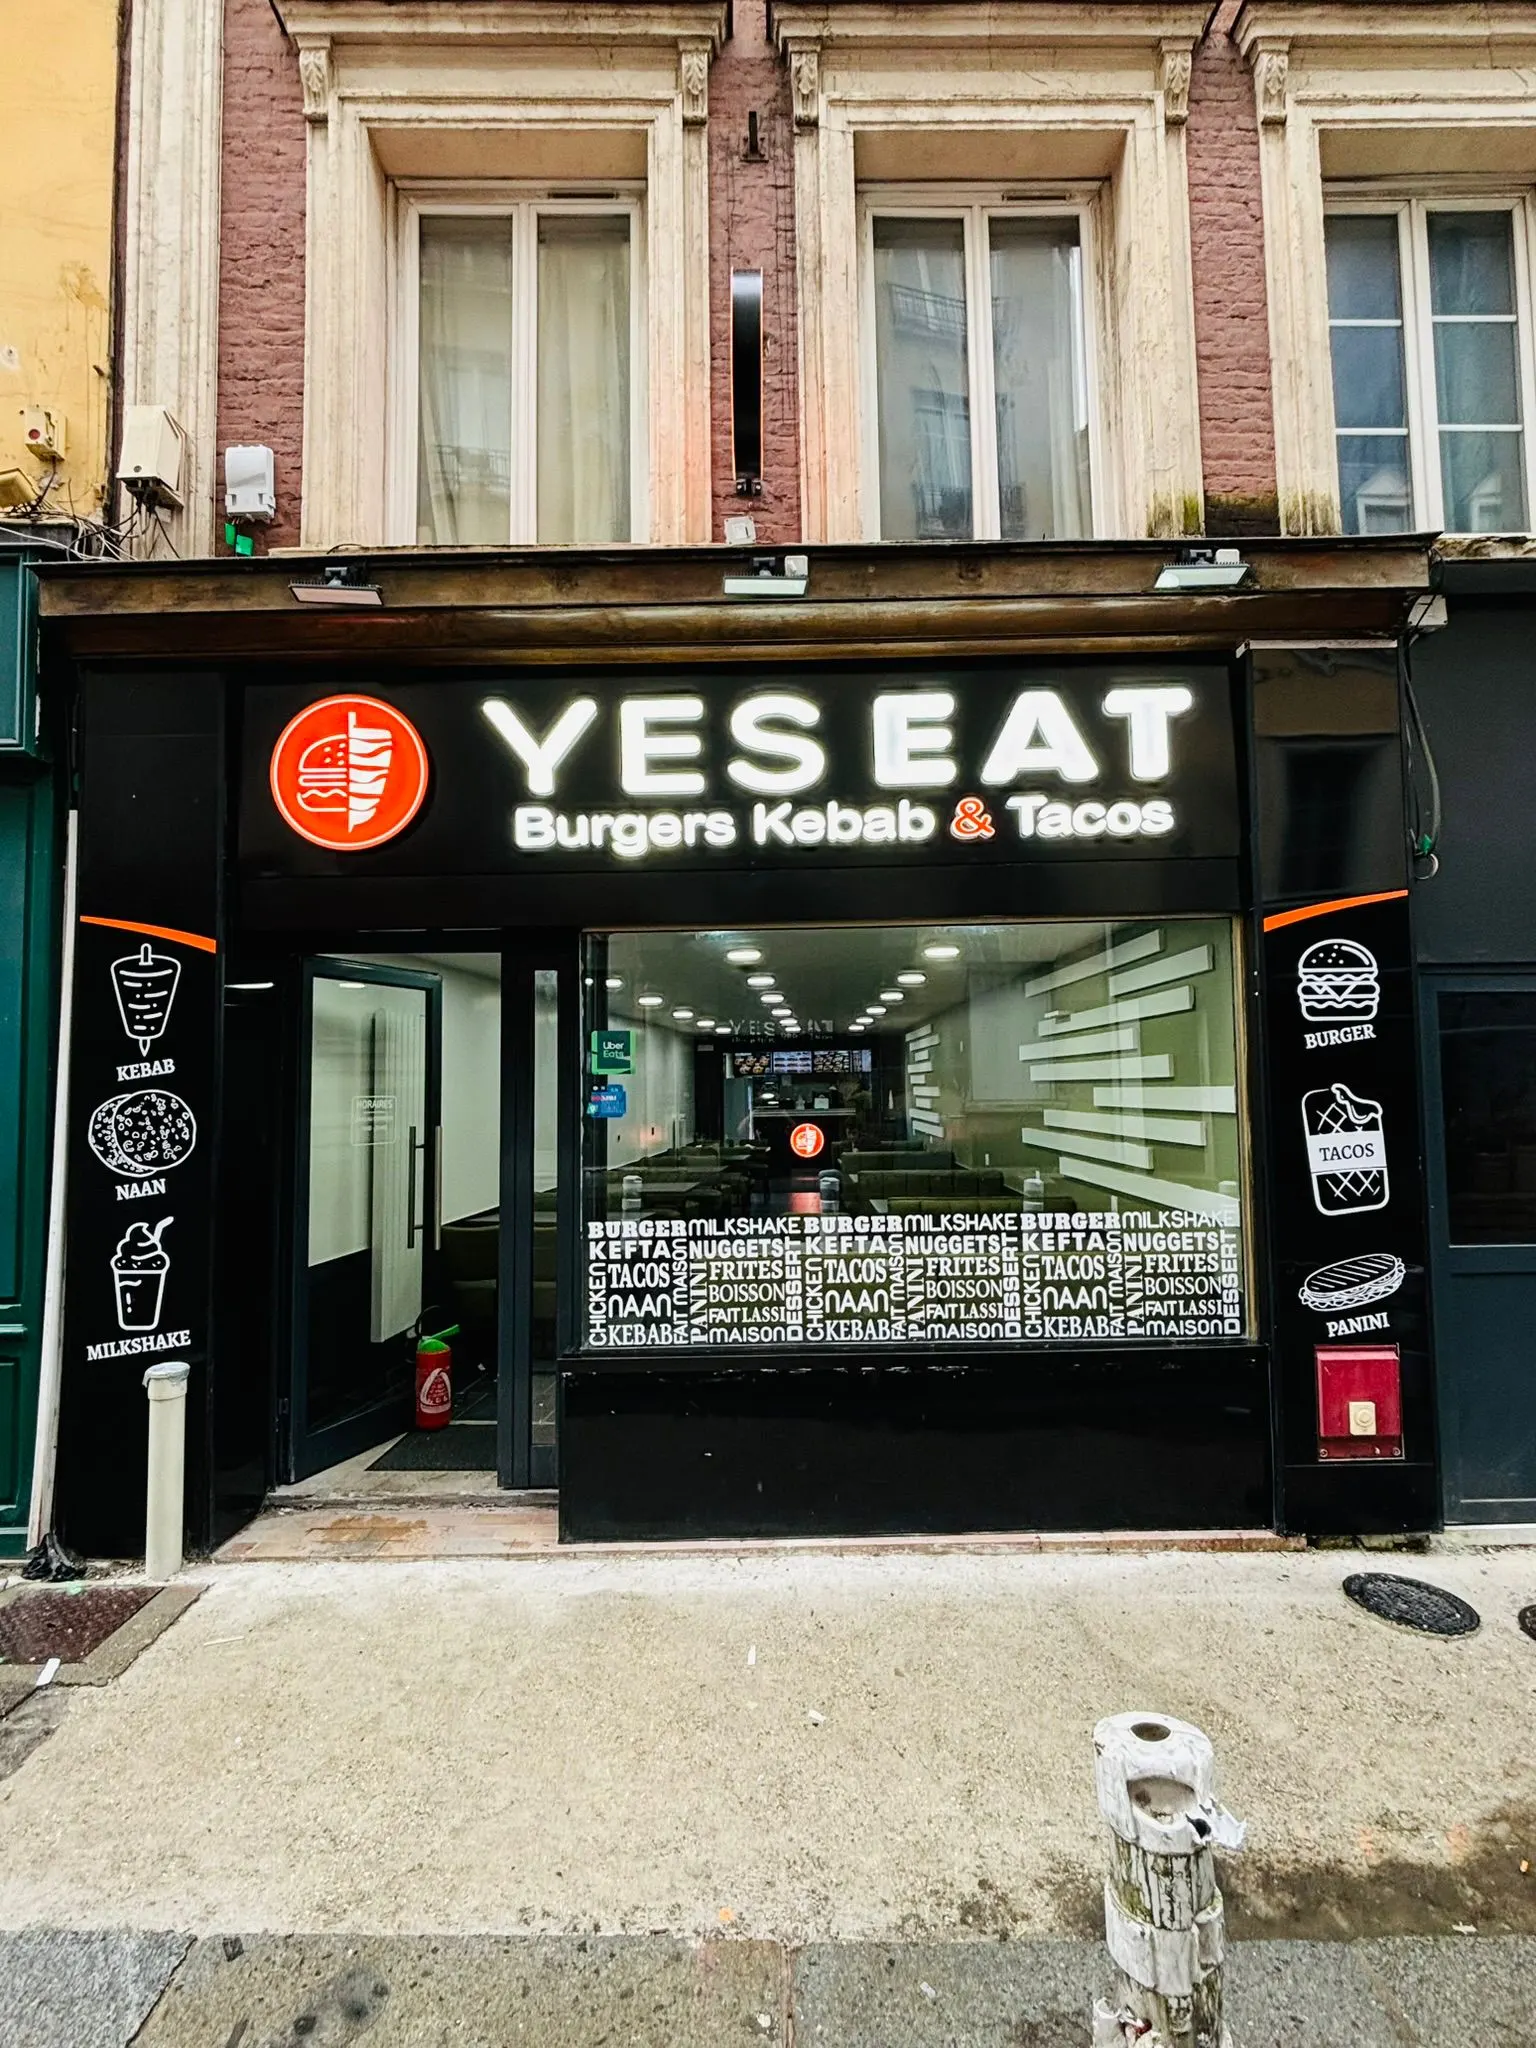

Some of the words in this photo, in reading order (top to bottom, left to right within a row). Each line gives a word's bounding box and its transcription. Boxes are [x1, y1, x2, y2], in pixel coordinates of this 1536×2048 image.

[482, 694, 826, 798] YES
[872, 686, 1194, 787] EAT
[513, 806, 738, 858] Burgers
[753, 799, 937, 845] Kebab
[950, 796, 995, 840] &
[1006, 793, 1176, 838] Tacos
[603, 1041, 625, 1050] Uber
[1304, 1023, 1377, 1049] BURGER
[603, 1050, 625, 1059] Eats
[116, 1058, 175, 1081] KEBAB
[1319, 1143, 1375, 1162] TACOS
[115, 1178, 166, 1200] NAAN
[588, 1219, 688, 1238] BURGER
[688, 1217, 801, 1237] MILKSHAKE
[804, 1215, 904, 1234] BURGER
[904, 1213, 1018, 1233] MILKSHAKE
[1021, 1212, 1121, 1231] BURGER
[589, 1239, 672, 1260] KEFTA
[689, 1238, 784, 1259] NUGGETS
[805, 1236, 888, 1255] KEFTA
[905, 1235, 1000, 1255] NUGGETS
[1022, 1232, 1105, 1252] KEFTA
[1124, 1231, 1219, 1252] NUGGETS
[709, 1260, 783, 1281] FRITES
[824, 1258, 887, 1284] TACOS
[926, 1257, 1000, 1277] FRITES
[1042, 1255, 1105, 1280] TACOS
[1145, 1253, 1219, 1273] FRITES
[608, 1262, 670, 1288] TACOS
[1001, 1233, 1021, 1338] DESSERT
[1221, 1229, 1240, 1335] DESSERT
[709, 1283, 785, 1303] BOISSON
[785, 1236, 803, 1341] DESSERT
[926, 1279, 1003, 1299] BOISSON
[1023, 1254, 1042, 1338] CHICKEN
[1125, 1254, 1145, 1336] PANINI
[1144, 1276, 1222, 1296] BOISSON
[588, 1262, 607, 1346] CHICKEN
[690, 1262, 709, 1344] PANINI
[805, 1257, 824, 1341] CHICKEN
[906, 1257, 926, 1340] PANINI
[1145, 1300, 1177, 1317] FAIT
[1179, 1300, 1223, 1316] LASSI
[709, 1308, 740, 1324] FAIT
[742, 1307, 786, 1323] LASSI
[926, 1304, 959, 1320] FAIT
[960, 1303, 1003, 1319] LASSI
[1109, 1302, 1125, 1336] FAIT
[673, 1310, 689, 1344] FAIT
[826, 1319, 891, 1341] KEBAB
[890, 1306, 906, 1340] FAIT
[1044, 1316, 1110, 1338] KEBAB
[1326, 1312, 1390, 1337] PANINI
[87, 1330, 192, 1361] MILKSHAKE
[608, 1324, 673, 1346] KEBAB
